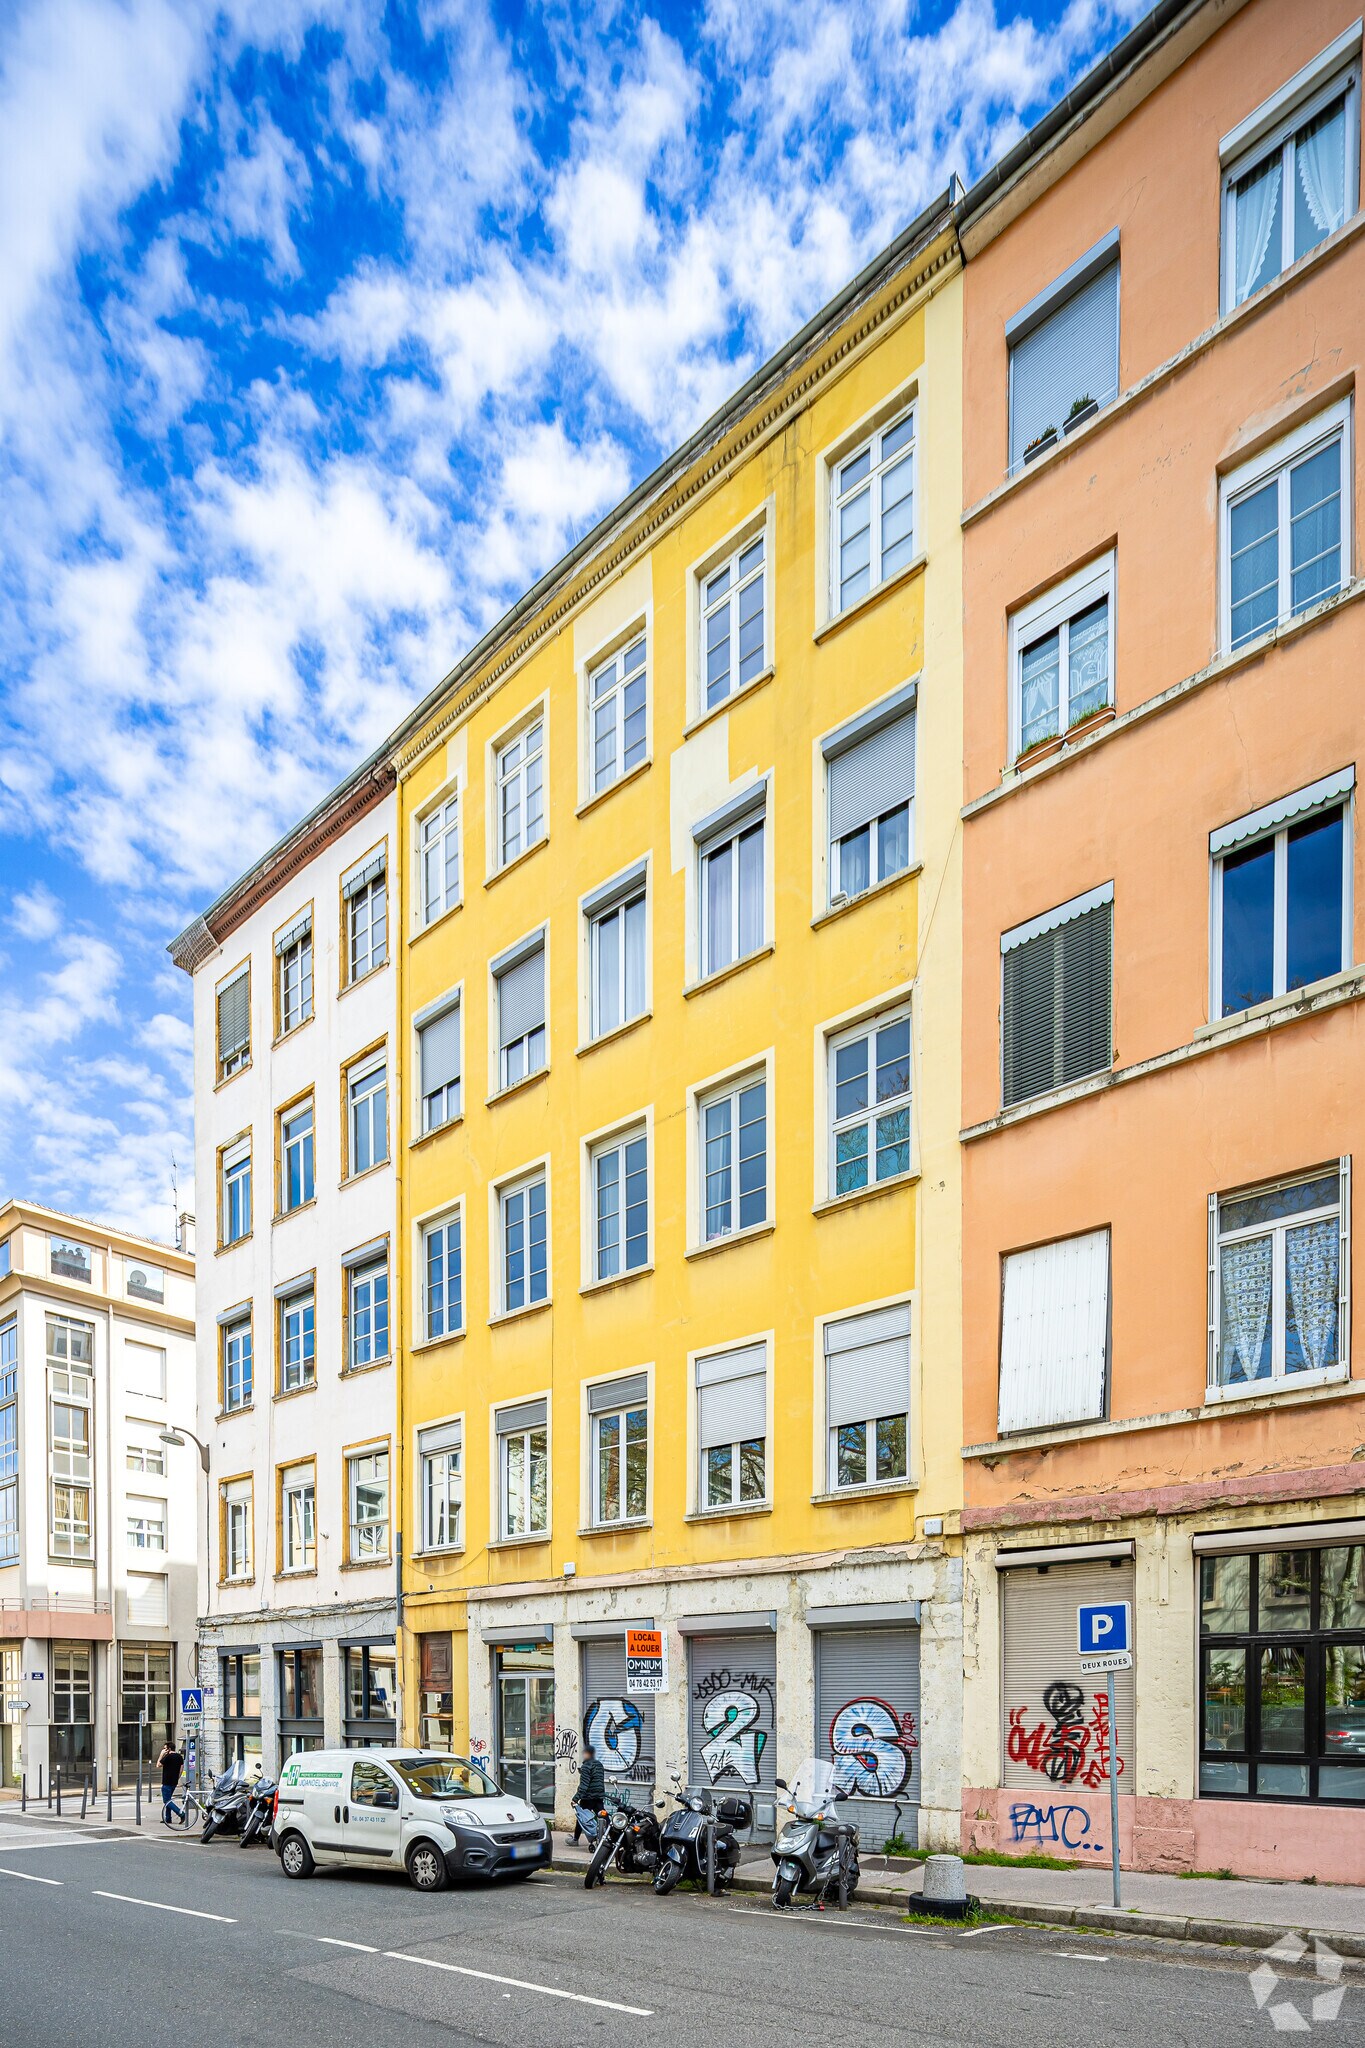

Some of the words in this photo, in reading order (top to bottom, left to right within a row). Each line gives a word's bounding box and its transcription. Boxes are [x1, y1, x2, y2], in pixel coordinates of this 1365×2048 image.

[1091, 1614, 1114, 1644] P
[634, 1633, 656, 1641] LOCAL
[630, 1644, 635, 1652] A
[628, 1659, 662, 1670] OMNIUM
[1082, 1661, 1102, 1670] DEUX
[1102, 1657, 1128, 1667] ROUES
[629, 1679, 635, 1687] 04
[636, 1679, 642, 1687] 78
[643, 1679, 649, 1687] 42
[650, 1679, 656, 1687] 53
[657, 1679, 662, 1687] 17
[190, 1741, 195, 1749] P
[322, 1779, 339, 1787] Service
